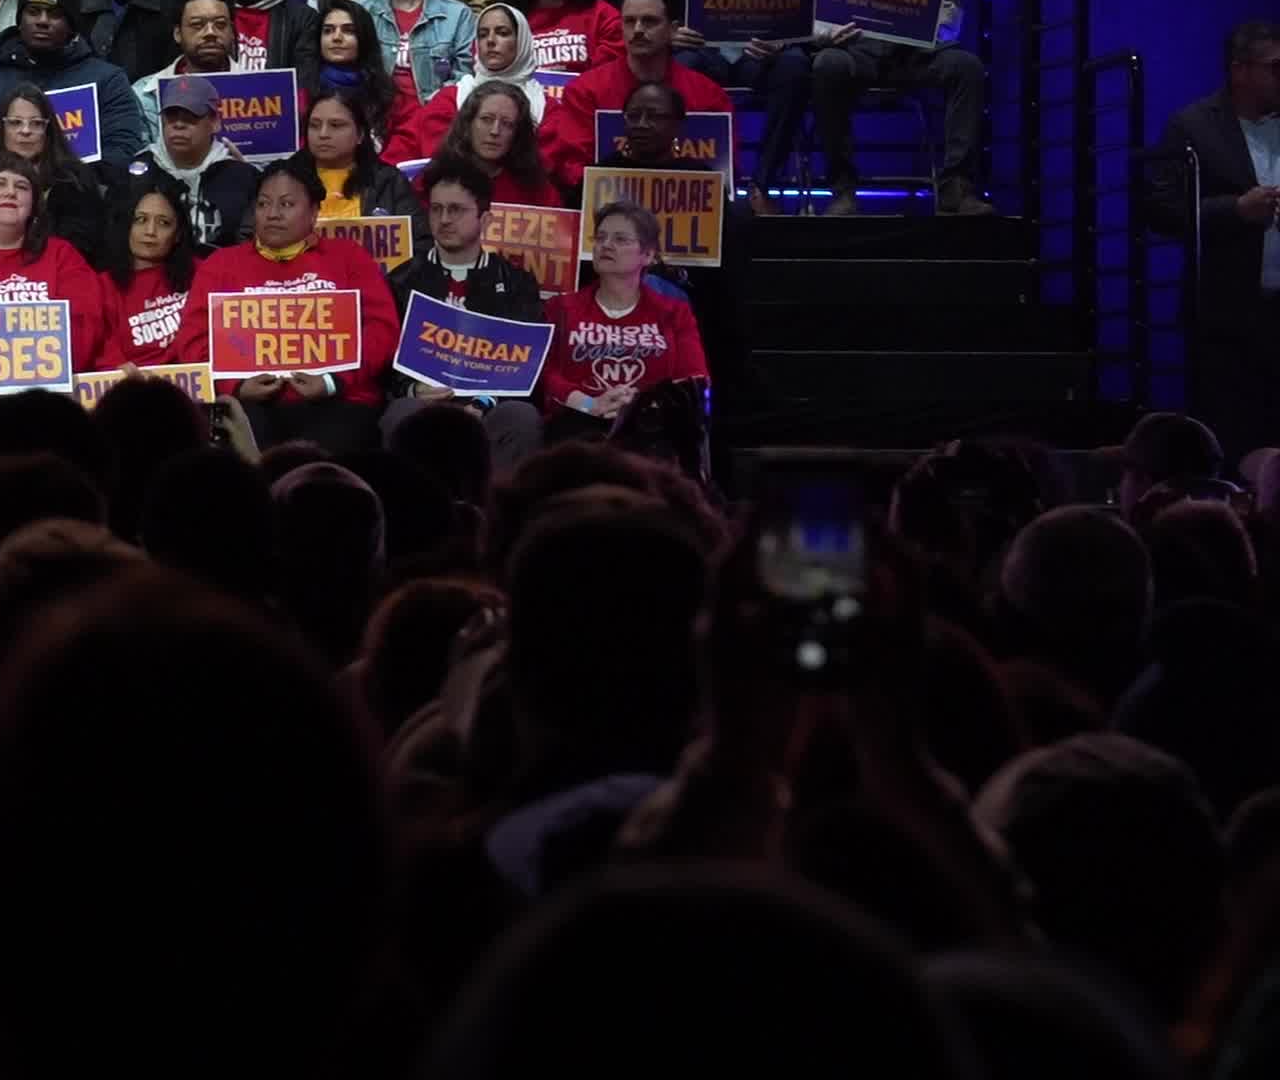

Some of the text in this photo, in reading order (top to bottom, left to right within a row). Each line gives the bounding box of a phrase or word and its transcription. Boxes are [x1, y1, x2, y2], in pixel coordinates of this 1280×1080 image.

[216, 97, 283, 120] HRAN
[486, 210, 558, 249] EEZE
[6, 306, 62, 333] FREE
[223, 297, 334, 331] FREEZE
[568, 330, 668, 350] NURSES
[578, 322, 659, 336] UNION
[256, 333, 351, 367] RENT
[419, 321, 532, 363] ZOHRAN
[435, 350, 461, 367] NEW
[464, 360, 493, 372] YORK
[494, 363, 521, 374] CITY
[603, 363, 640, 382] NY
